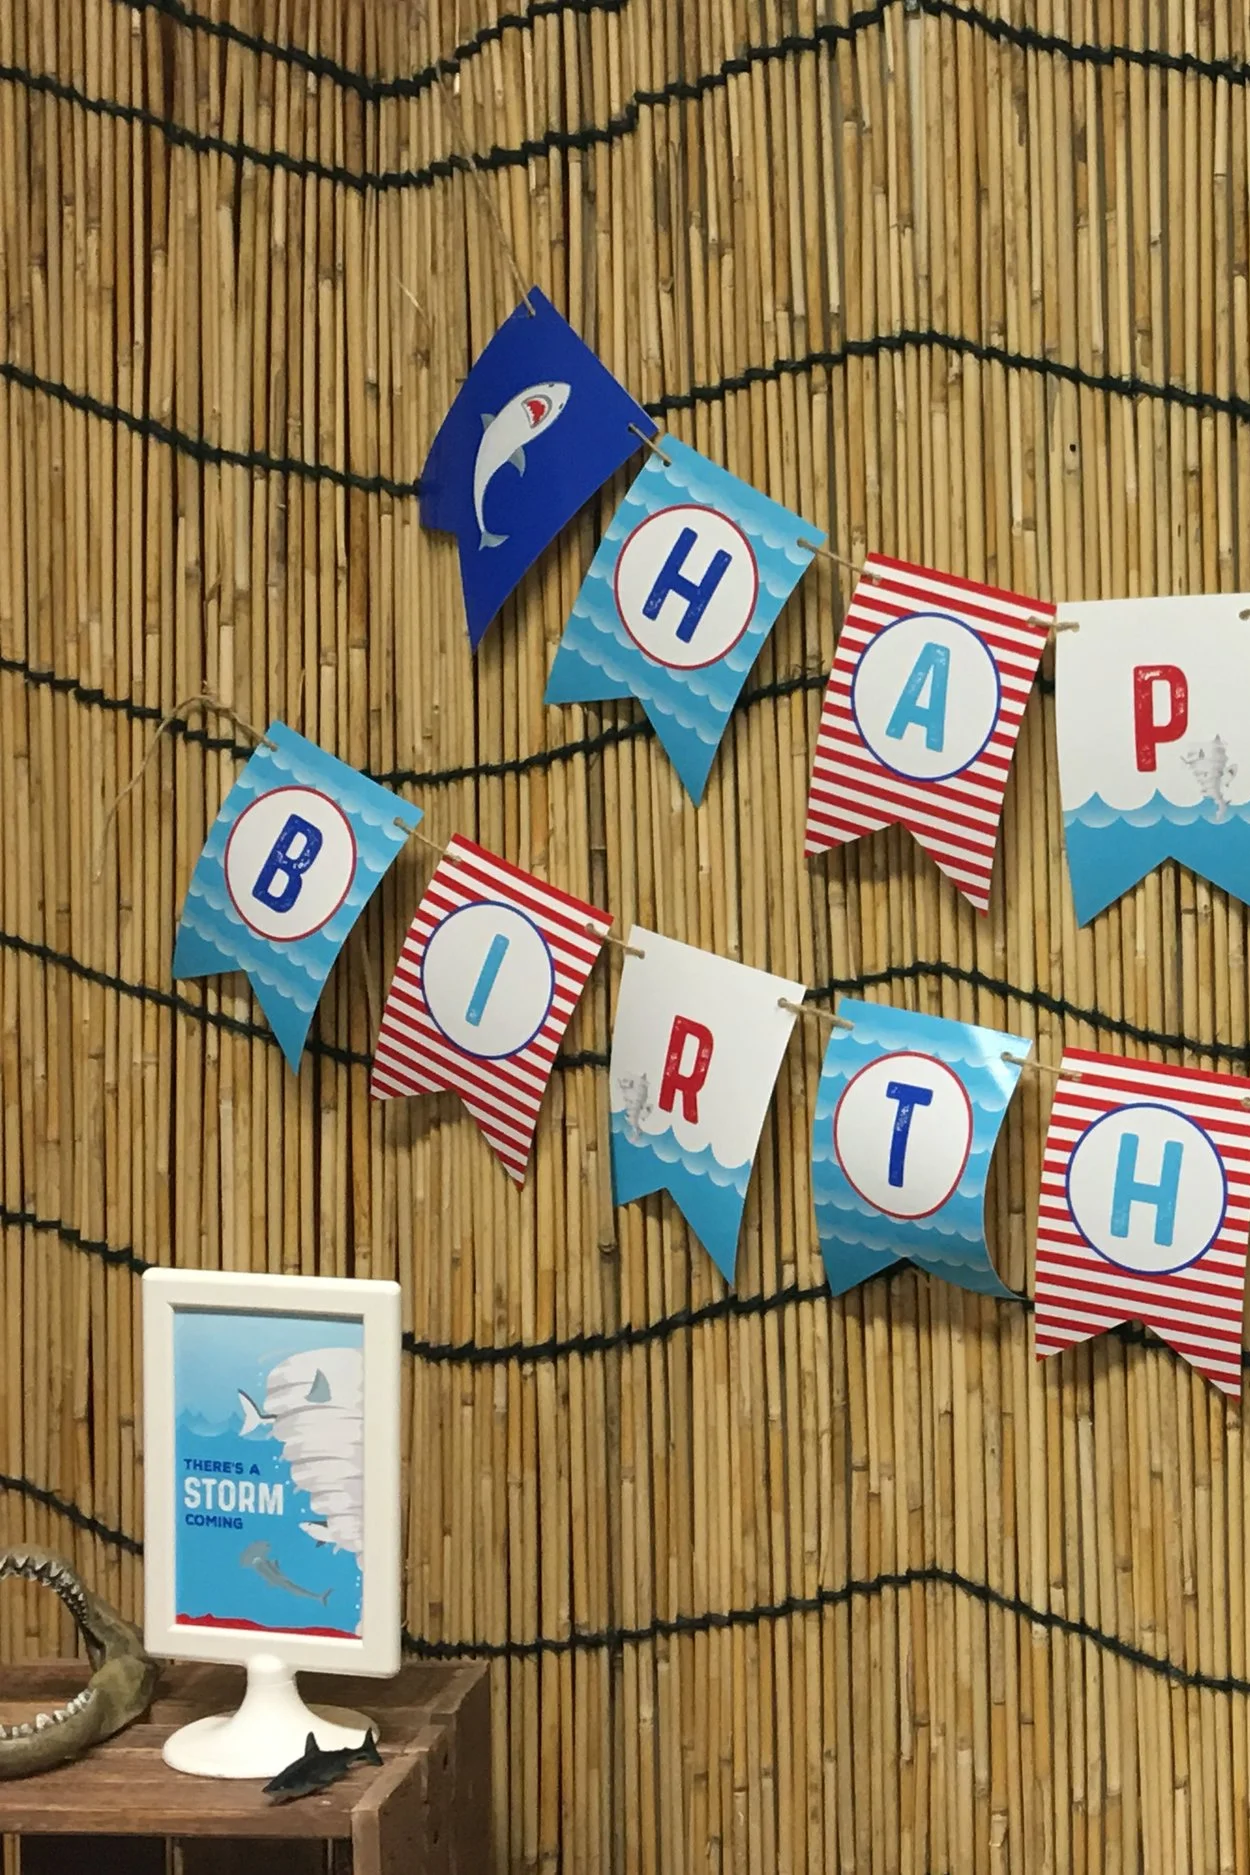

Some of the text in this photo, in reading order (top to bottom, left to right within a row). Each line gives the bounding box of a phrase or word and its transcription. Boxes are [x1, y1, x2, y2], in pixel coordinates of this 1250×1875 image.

[183, 1458, 261, 1476] THERE'S A
[184, 1477, 284, 1515] STORM
[185, 1513, 244, 1530] COMING
